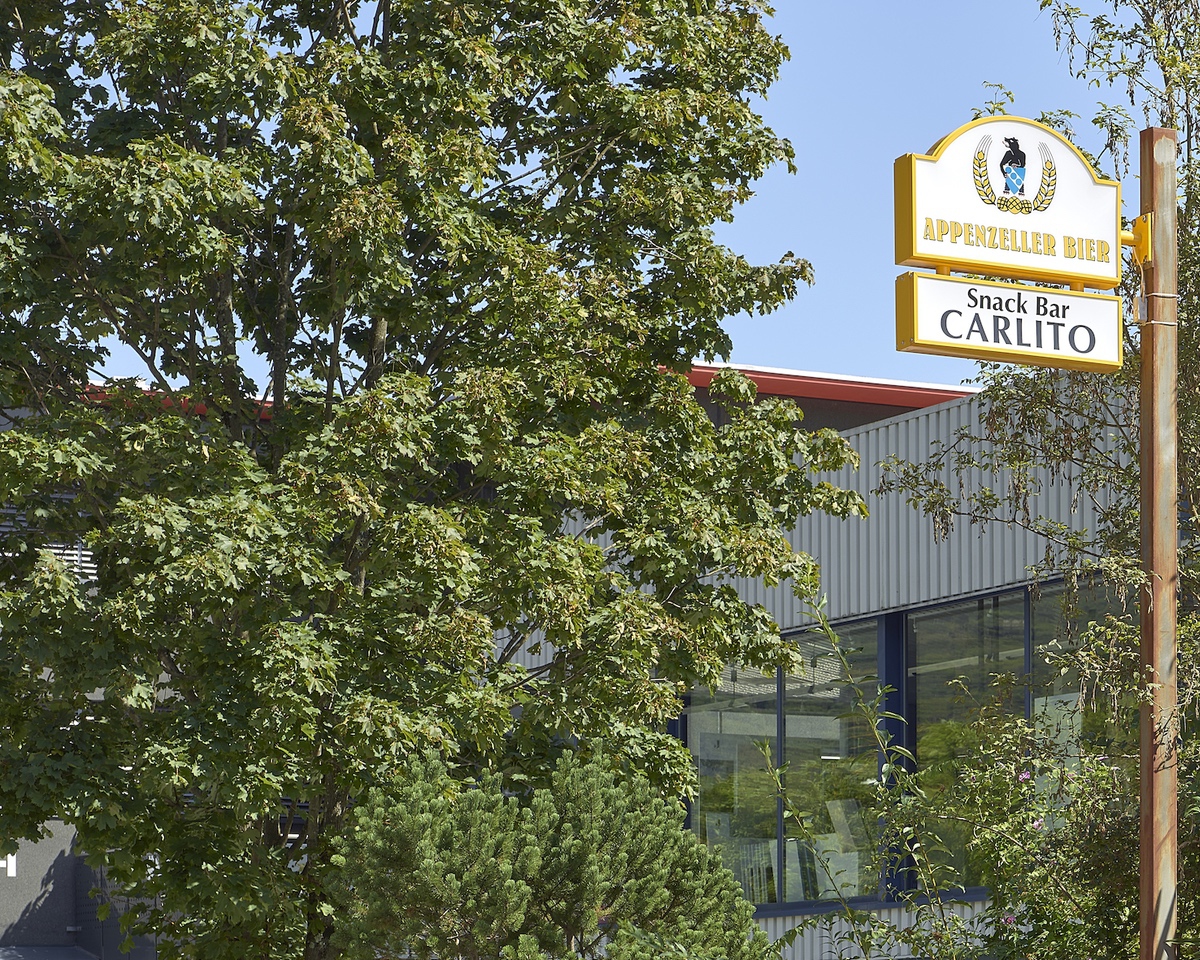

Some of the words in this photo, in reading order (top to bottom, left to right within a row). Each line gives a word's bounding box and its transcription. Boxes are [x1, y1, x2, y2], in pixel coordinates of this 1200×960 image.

[923, 217, 1056, 256] APPENZELLER
[1063, 236, 1110, 263] BIER
[967, 288, 1028, 314] Snack
[1036, 297, 1070, 318] Bar
[940, 309, 1095, 353] CARLITO
